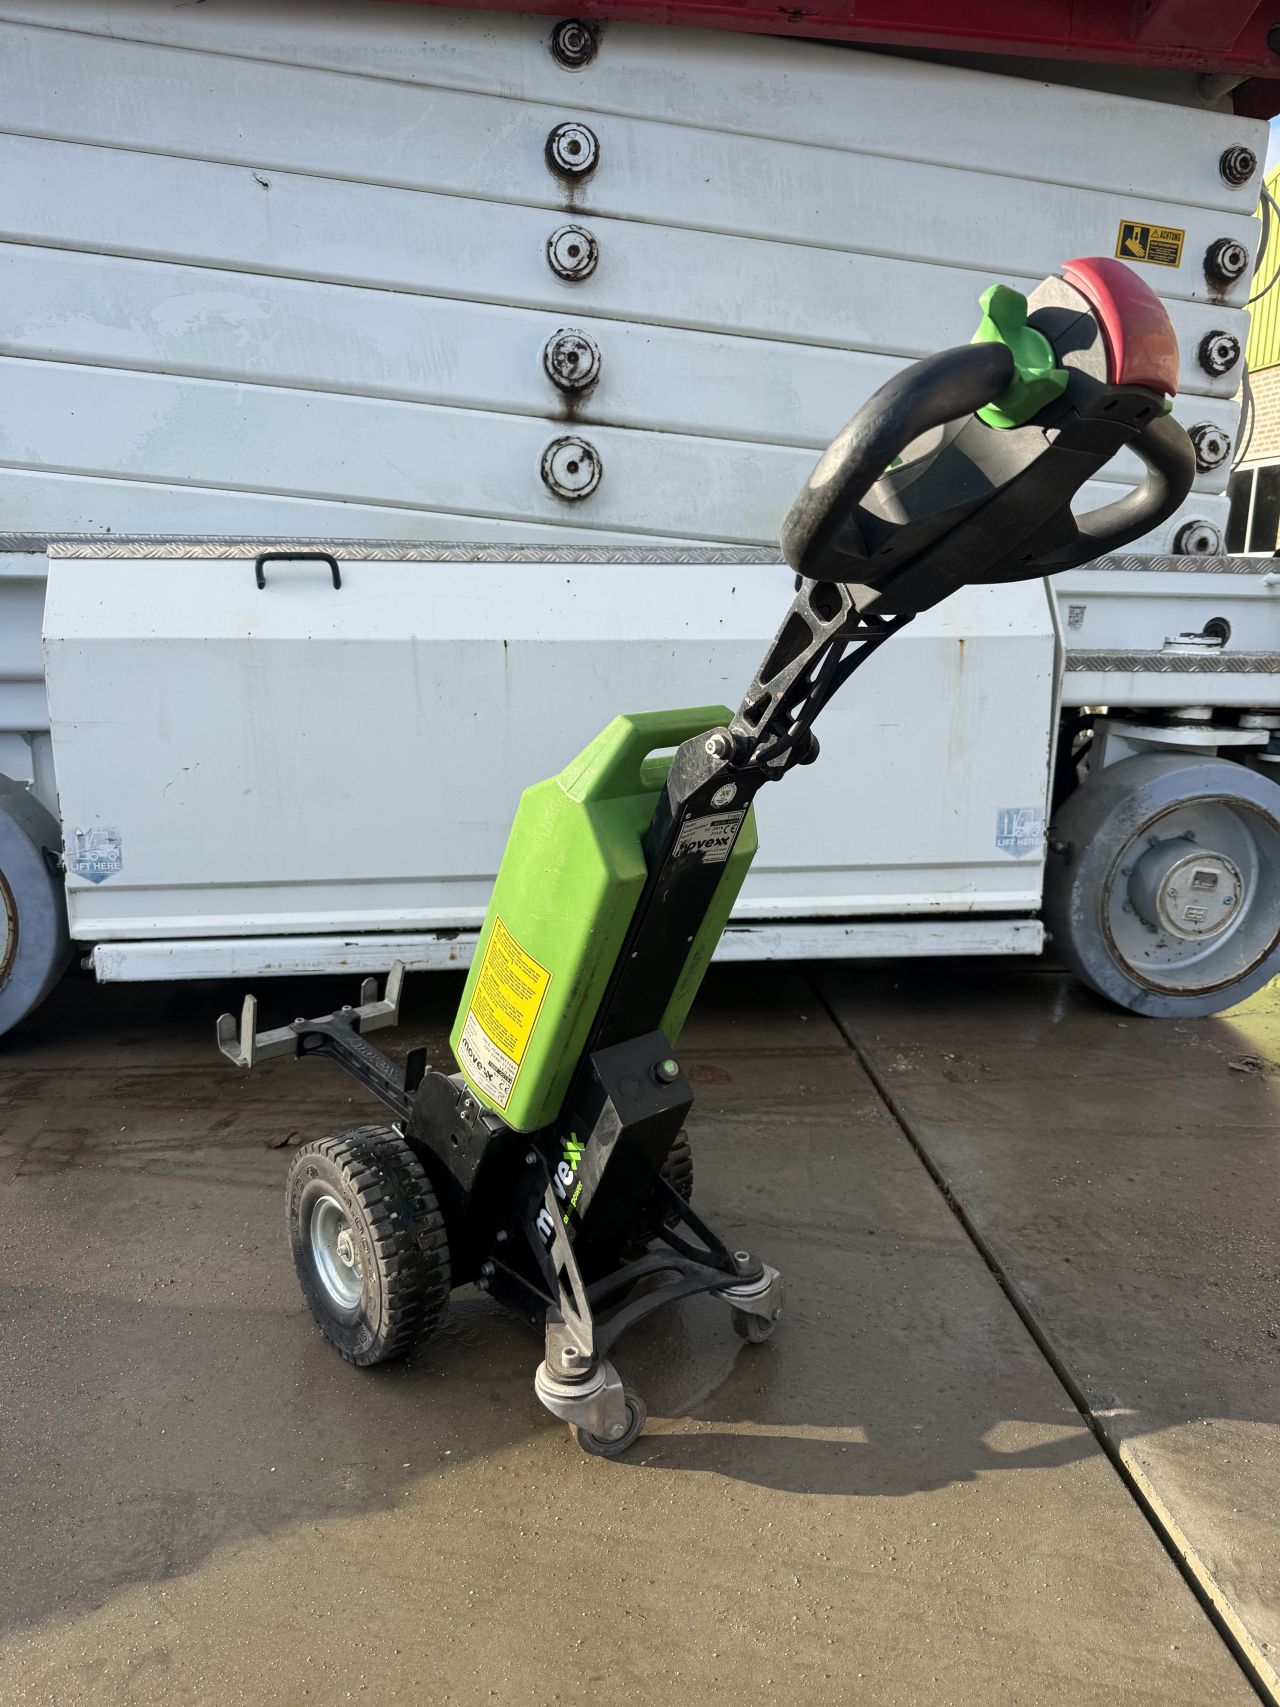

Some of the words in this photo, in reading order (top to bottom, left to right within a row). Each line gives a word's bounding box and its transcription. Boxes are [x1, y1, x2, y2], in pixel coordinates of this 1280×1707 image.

[1160, 230, 1181, 242] ACHTUNG
[70, 862, 90, 871] LIFT
[93, 862, 121, 871] HERE
[536, 1132, 585, 1246] mvexx
